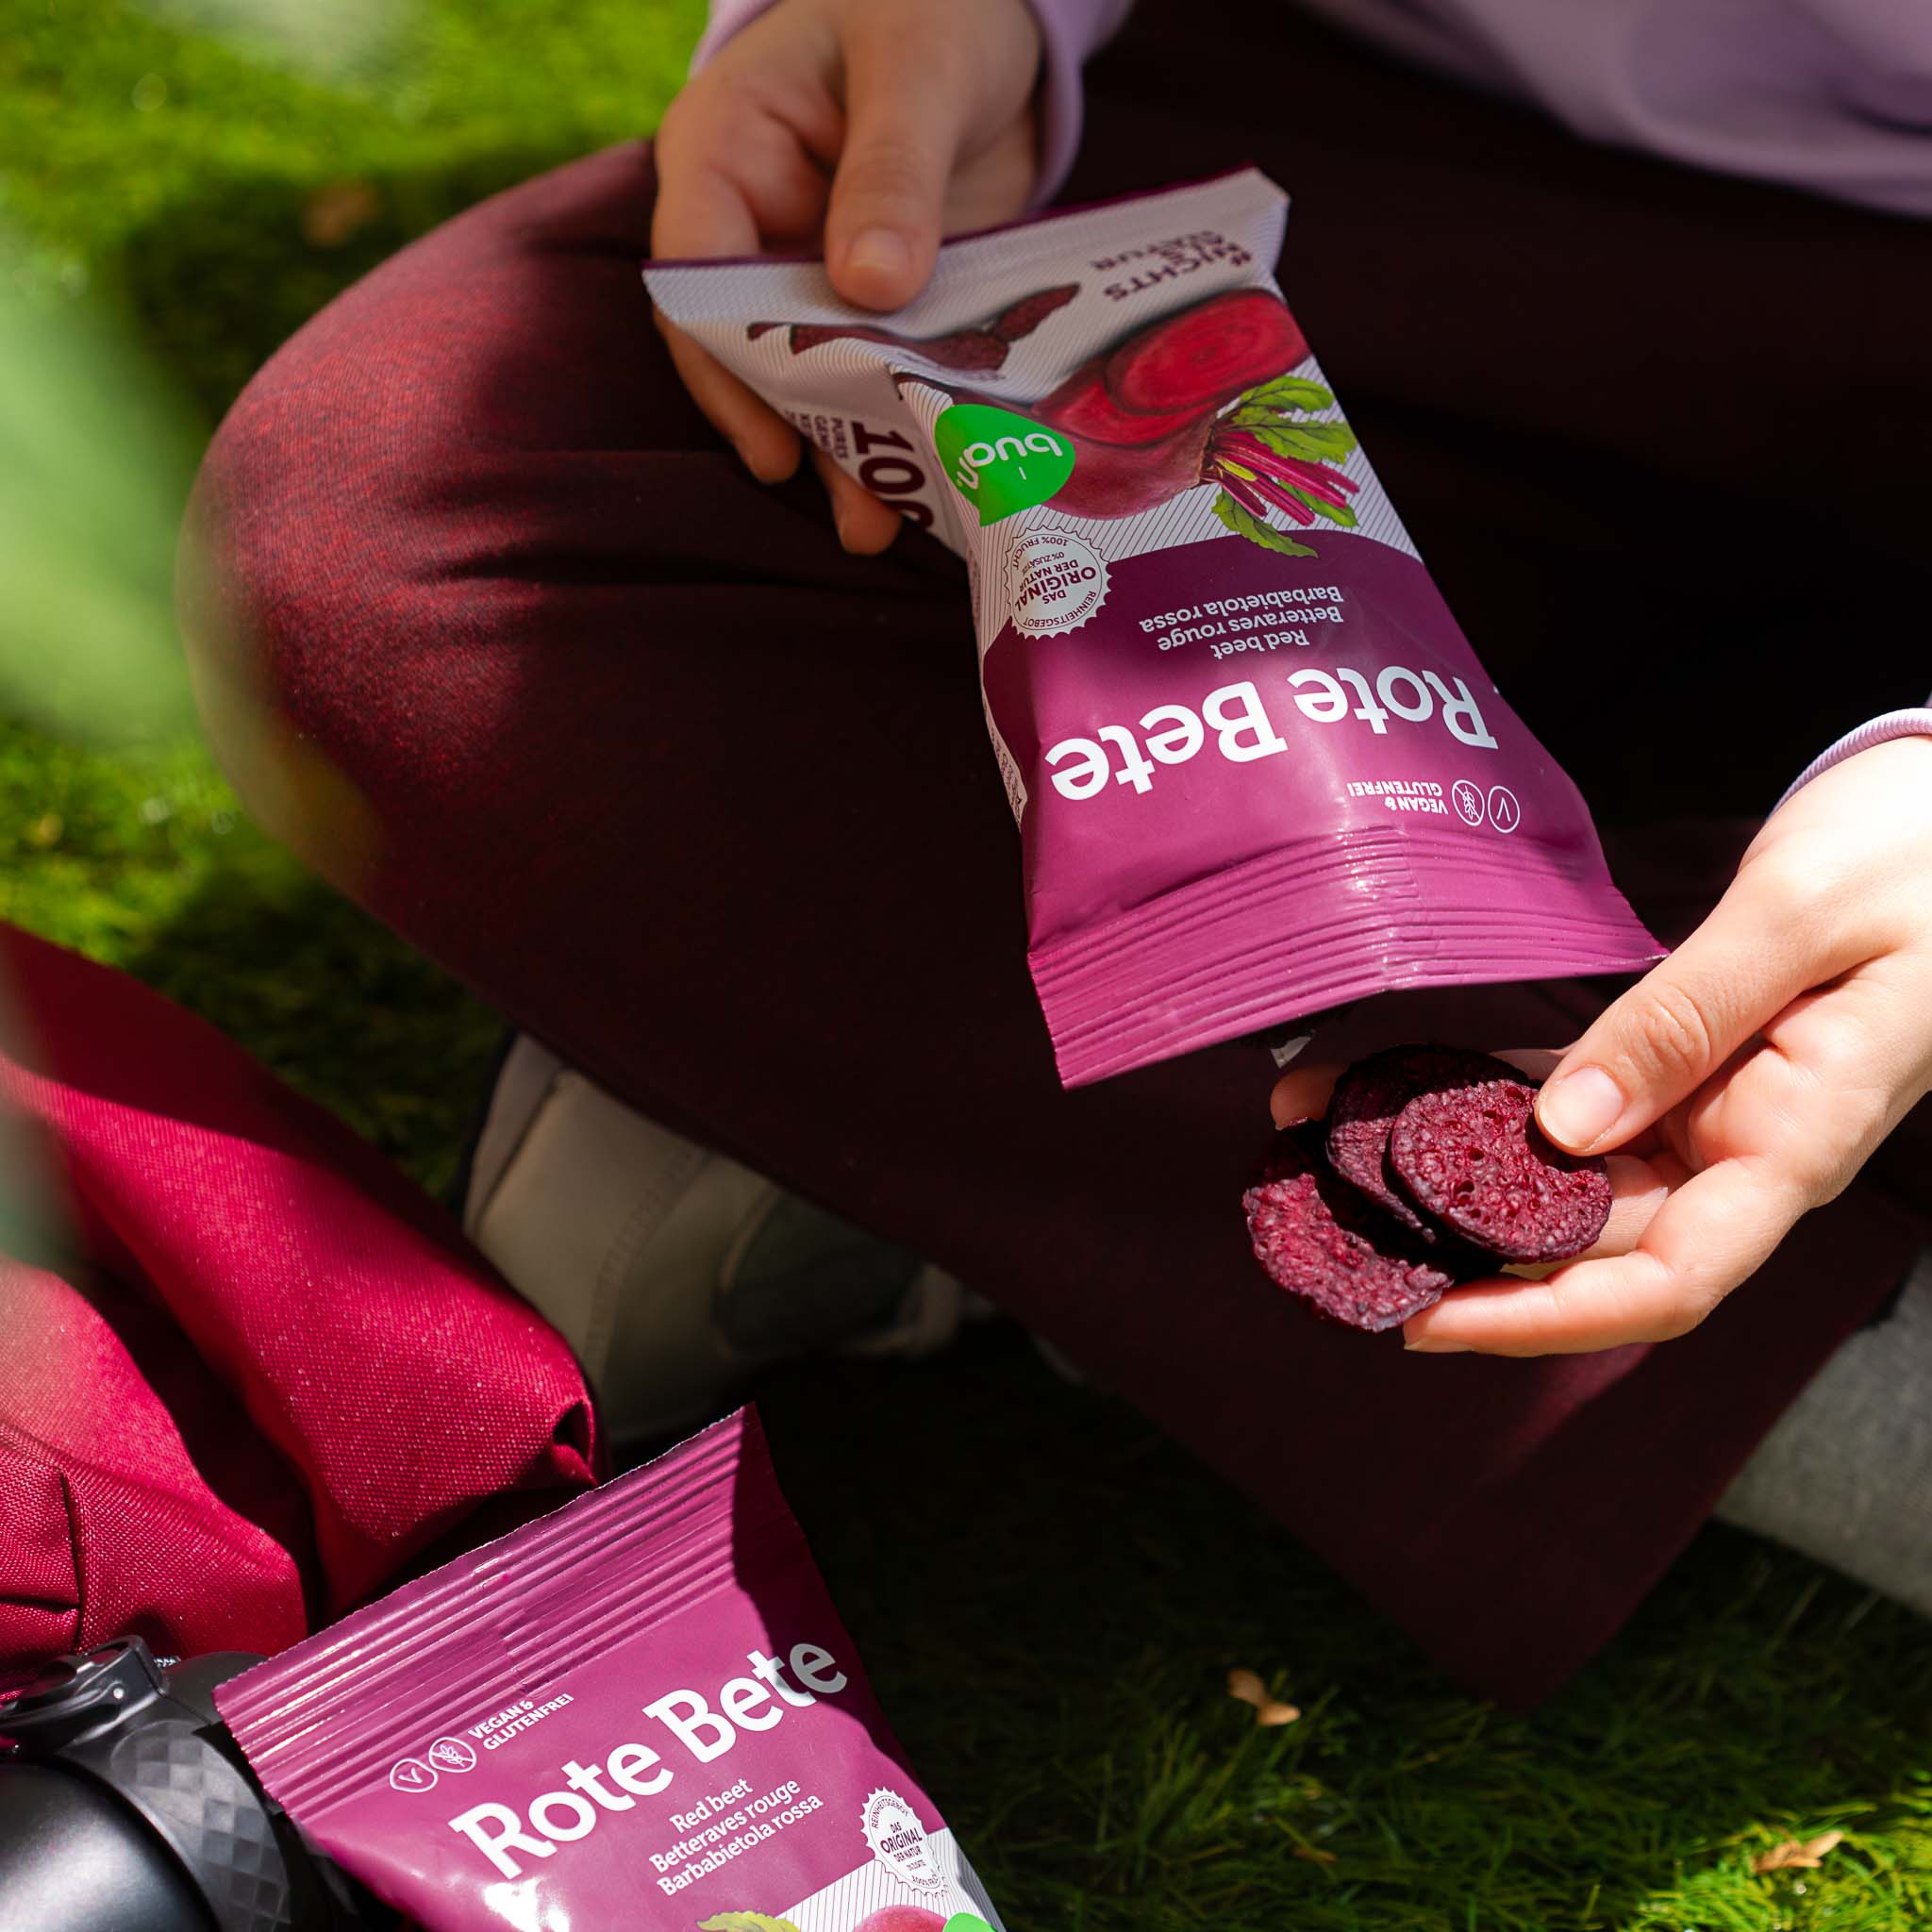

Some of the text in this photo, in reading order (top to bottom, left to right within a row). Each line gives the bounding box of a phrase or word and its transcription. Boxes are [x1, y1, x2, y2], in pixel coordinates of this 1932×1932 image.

[1013, 536, 1069, 570] 100% FRUCHT
[1015, 566, 1096, 611] ORIGINAL
[1019, 559, 1079, 592] DER NATUR
[1023, 591, 1096, 627] REINHEITSGEBOT
[1041, 590, 1067, 604] DAS
[1139, 586, 1344, 633] Barbabietola rossa
[1157, 607, 1344, 651] Betteraves rouge
[1209, 629, 1310, 659] Red beet
[1286, 665, 1499, 750] Rote
[1044, 680, 1289, 801] Bete
[1346, 779, 1443, 798] GLUTENFREI
[1397, 797, 1449, 815] VEGAN
[468, 1706, 524, 1740] VEGAN
[482, 1692, 575, 1751] GLUTENFREI
[448, 1642, 848, 1879] Rote Bete
[669, 1777, 754, 1834] Red beet
[648, 1779, 802, 1874] Betteraves rouge
[656, 1794, 824, 1897] Barbabietola rossa
[880, 1827, 923, 1854] ORIGINAL
[890, 1822, 902, 1834] DAS
